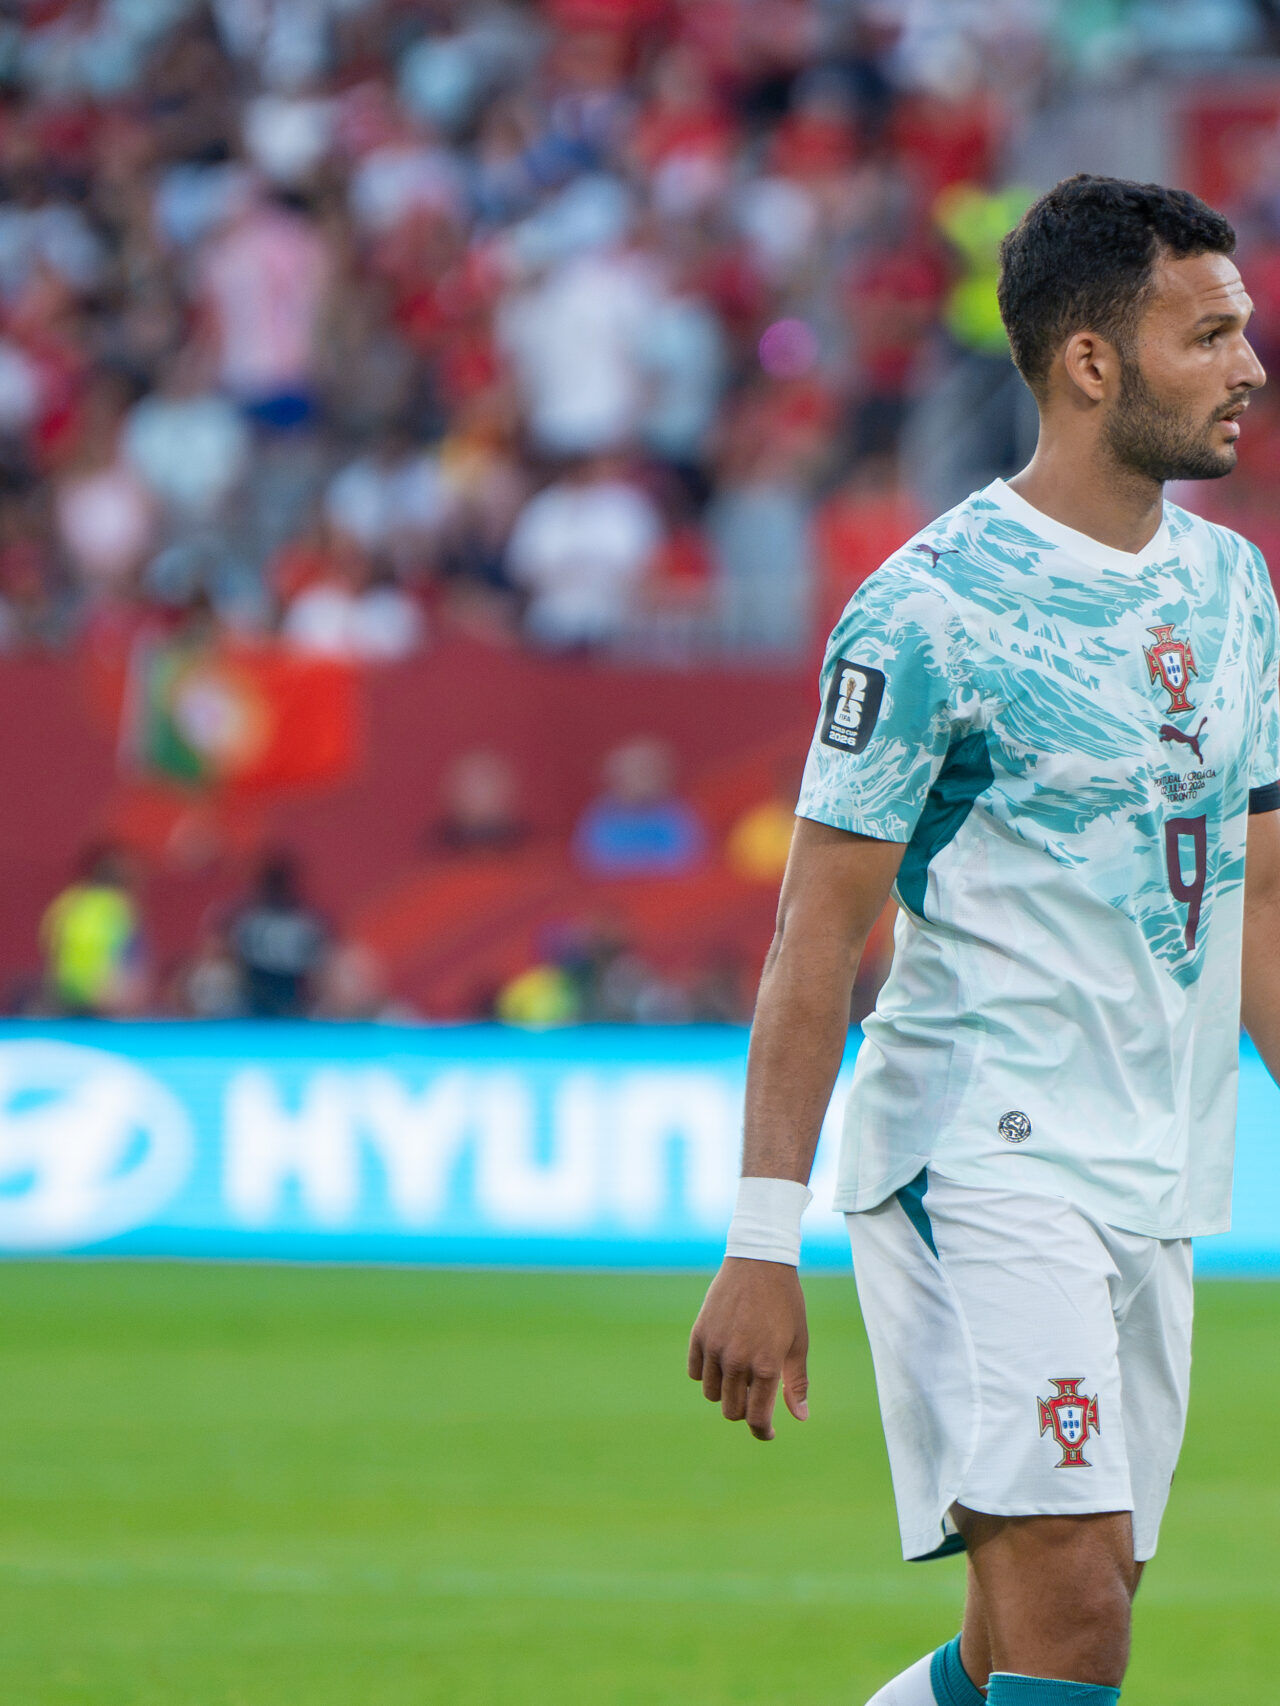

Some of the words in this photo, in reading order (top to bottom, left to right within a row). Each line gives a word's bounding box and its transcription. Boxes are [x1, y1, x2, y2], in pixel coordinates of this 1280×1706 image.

[829, 731, 856, 746] 2026
[1166, 790, 1198, 803] TORONTO
[1164, 814, 1207, 951] 9
